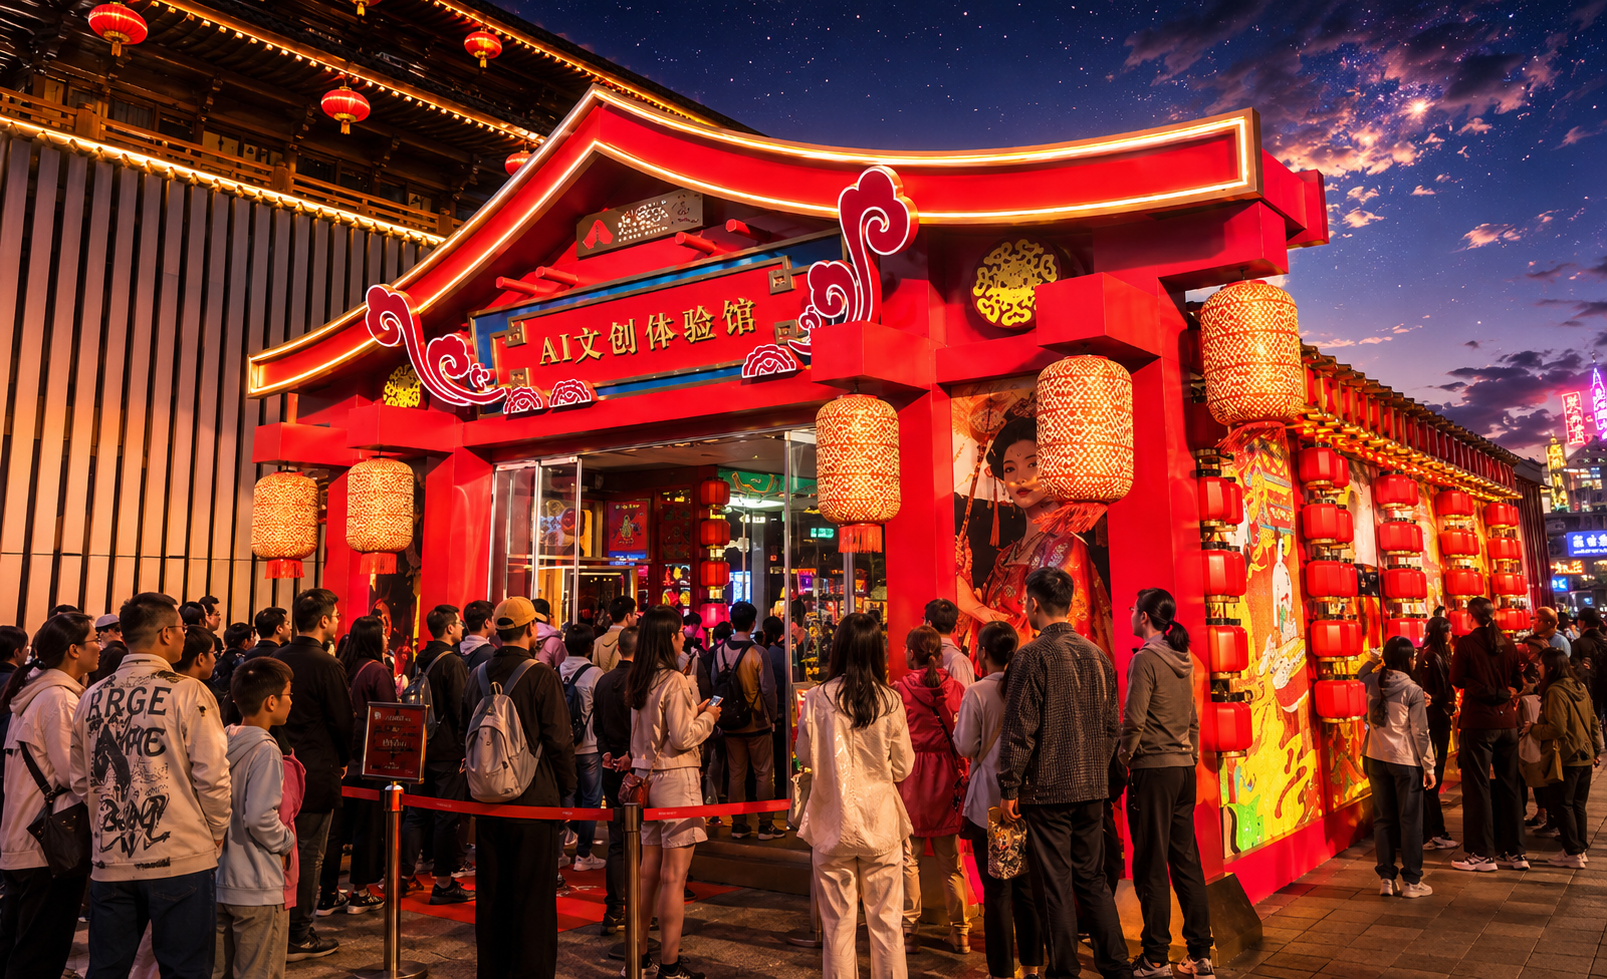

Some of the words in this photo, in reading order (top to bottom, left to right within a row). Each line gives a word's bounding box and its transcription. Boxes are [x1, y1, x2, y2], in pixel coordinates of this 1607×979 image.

[539, 297, 756, 366] AI文创体验馆
